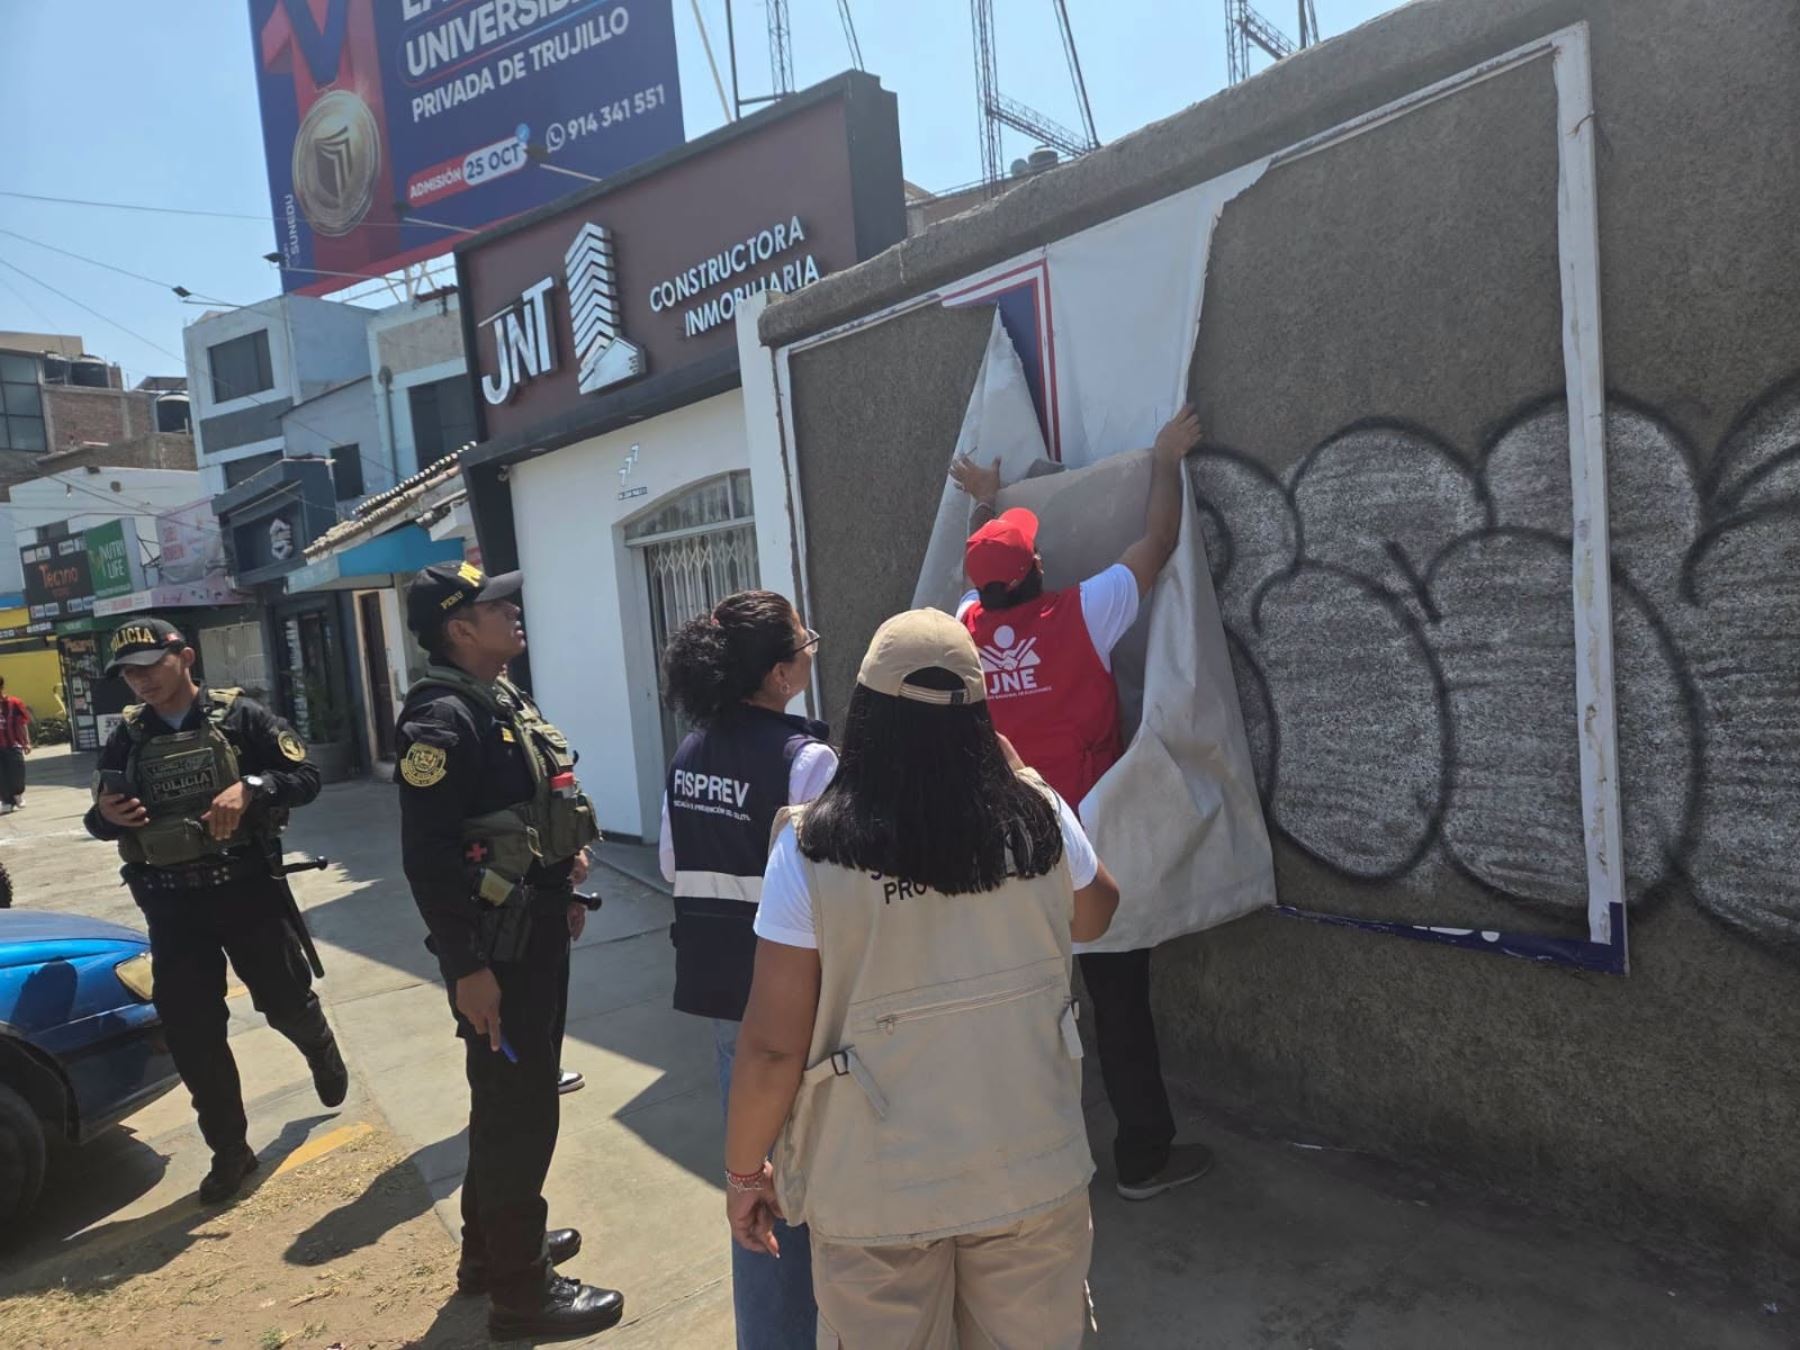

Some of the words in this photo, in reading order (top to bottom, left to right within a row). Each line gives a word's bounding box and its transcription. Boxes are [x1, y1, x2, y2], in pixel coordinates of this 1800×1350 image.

[412, 67, 495, 122] PRIVADA
[498, 52, 526, 86] DE
[529, 7, 629, 71] TRUJILLO
[567, 113, 599, 140] 914
[600, 98, 632, 128] 341
[634, 84, 666, 114] 551
[410, 166, 462, 199] ADMISIÓN
[466, 158, 485, 180] 25
[488, 143, 521, 171] OCT
[650, 216, 805, 312] CONSTRUCTORA
[481, 276, 554, 405] JNT
[107, 559, 126, 579] LIFE
[989, 668, 1037, 694] JNE
[674, 768, 750, 809] FISPREV
[883, 879, 928, 904] PRO
